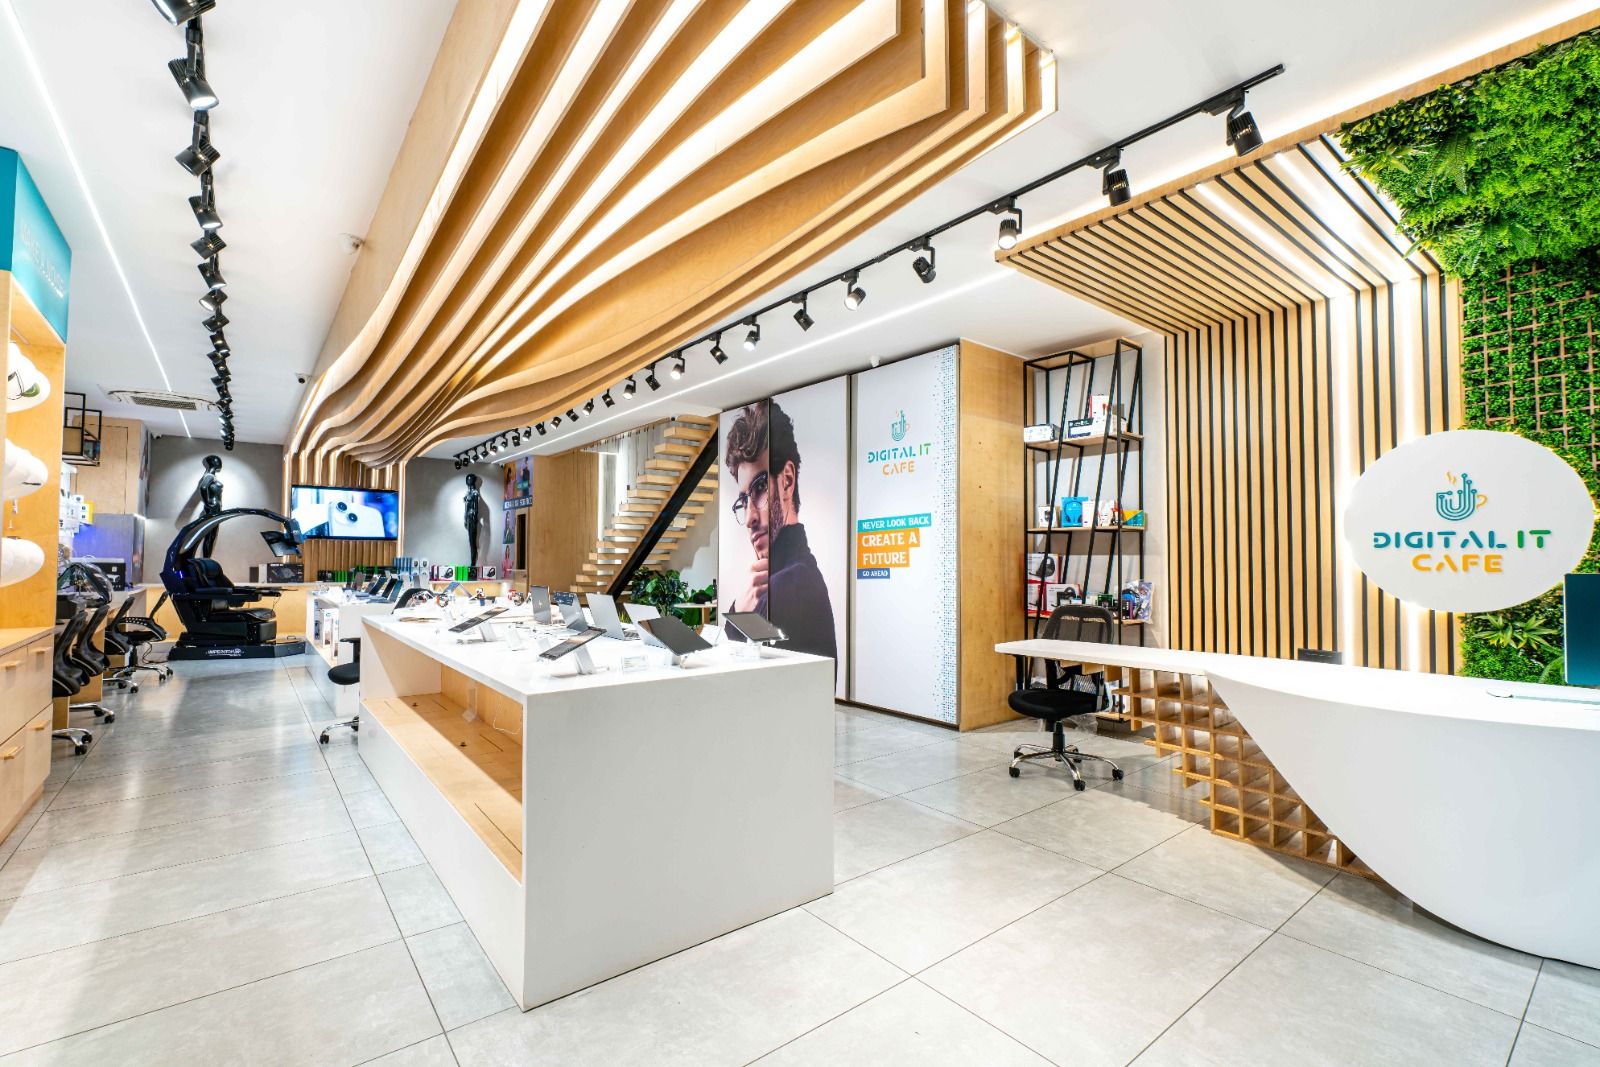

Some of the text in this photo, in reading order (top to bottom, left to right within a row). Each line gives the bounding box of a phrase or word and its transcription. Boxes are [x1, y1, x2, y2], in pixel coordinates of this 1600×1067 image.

[868, 443, 932, 463] DIGITAL IT
[882, 460, 916, 475] CAFE
[862, 515, 929, 530] NEVER LOOK BACK
[862, 531, 918, 547] CREATE A
[1373, 529, 1552, 549] DIGITAL IT
[862, 552, 907, 566] FUTURE
[1411, 553, 1504, 573] CAFE
